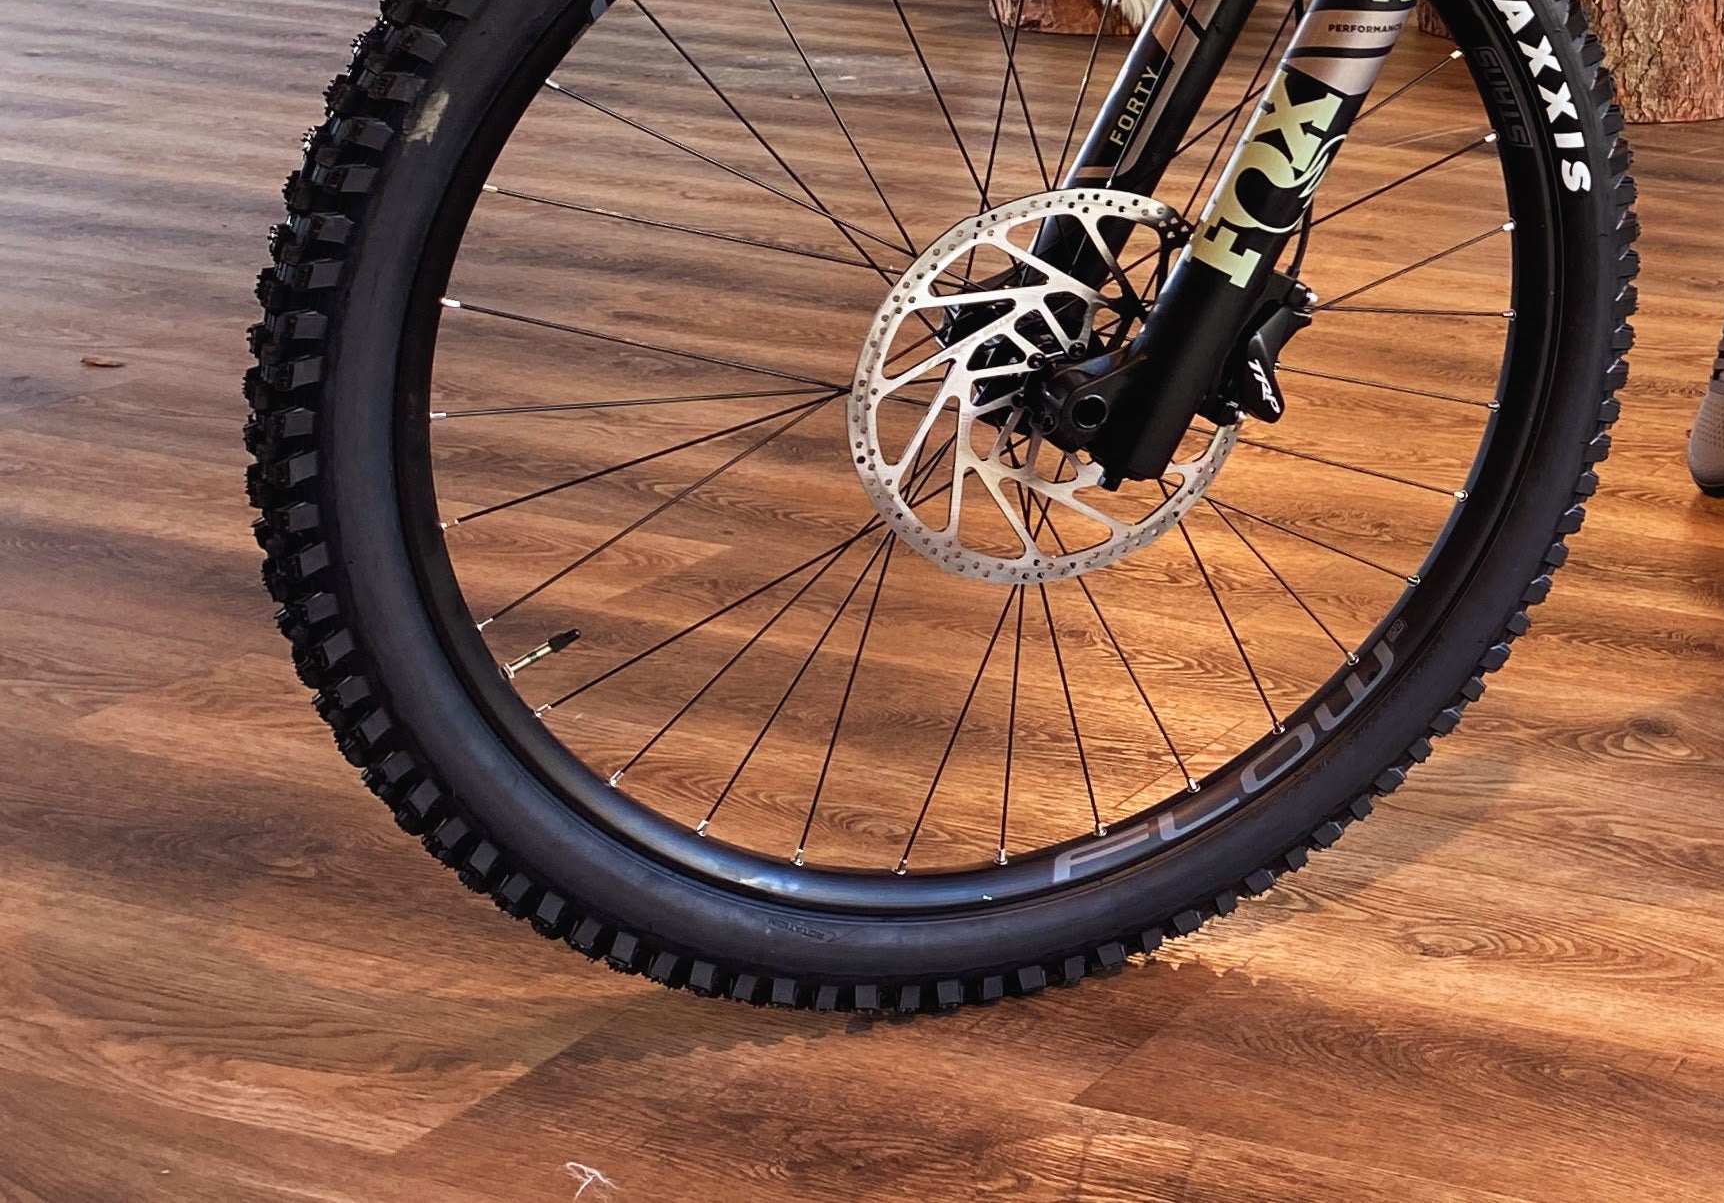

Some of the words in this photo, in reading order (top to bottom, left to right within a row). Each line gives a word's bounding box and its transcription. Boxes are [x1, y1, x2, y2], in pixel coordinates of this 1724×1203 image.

[1328, 22, 1404, 35] PERFORMANC
[1109, 65, 1160, 147] FORTY
[1191, 69, 1348, 289] FOX
[1247, 358, 1281, 414] TRP
[1052, 639, 1395, 884] FLOW
